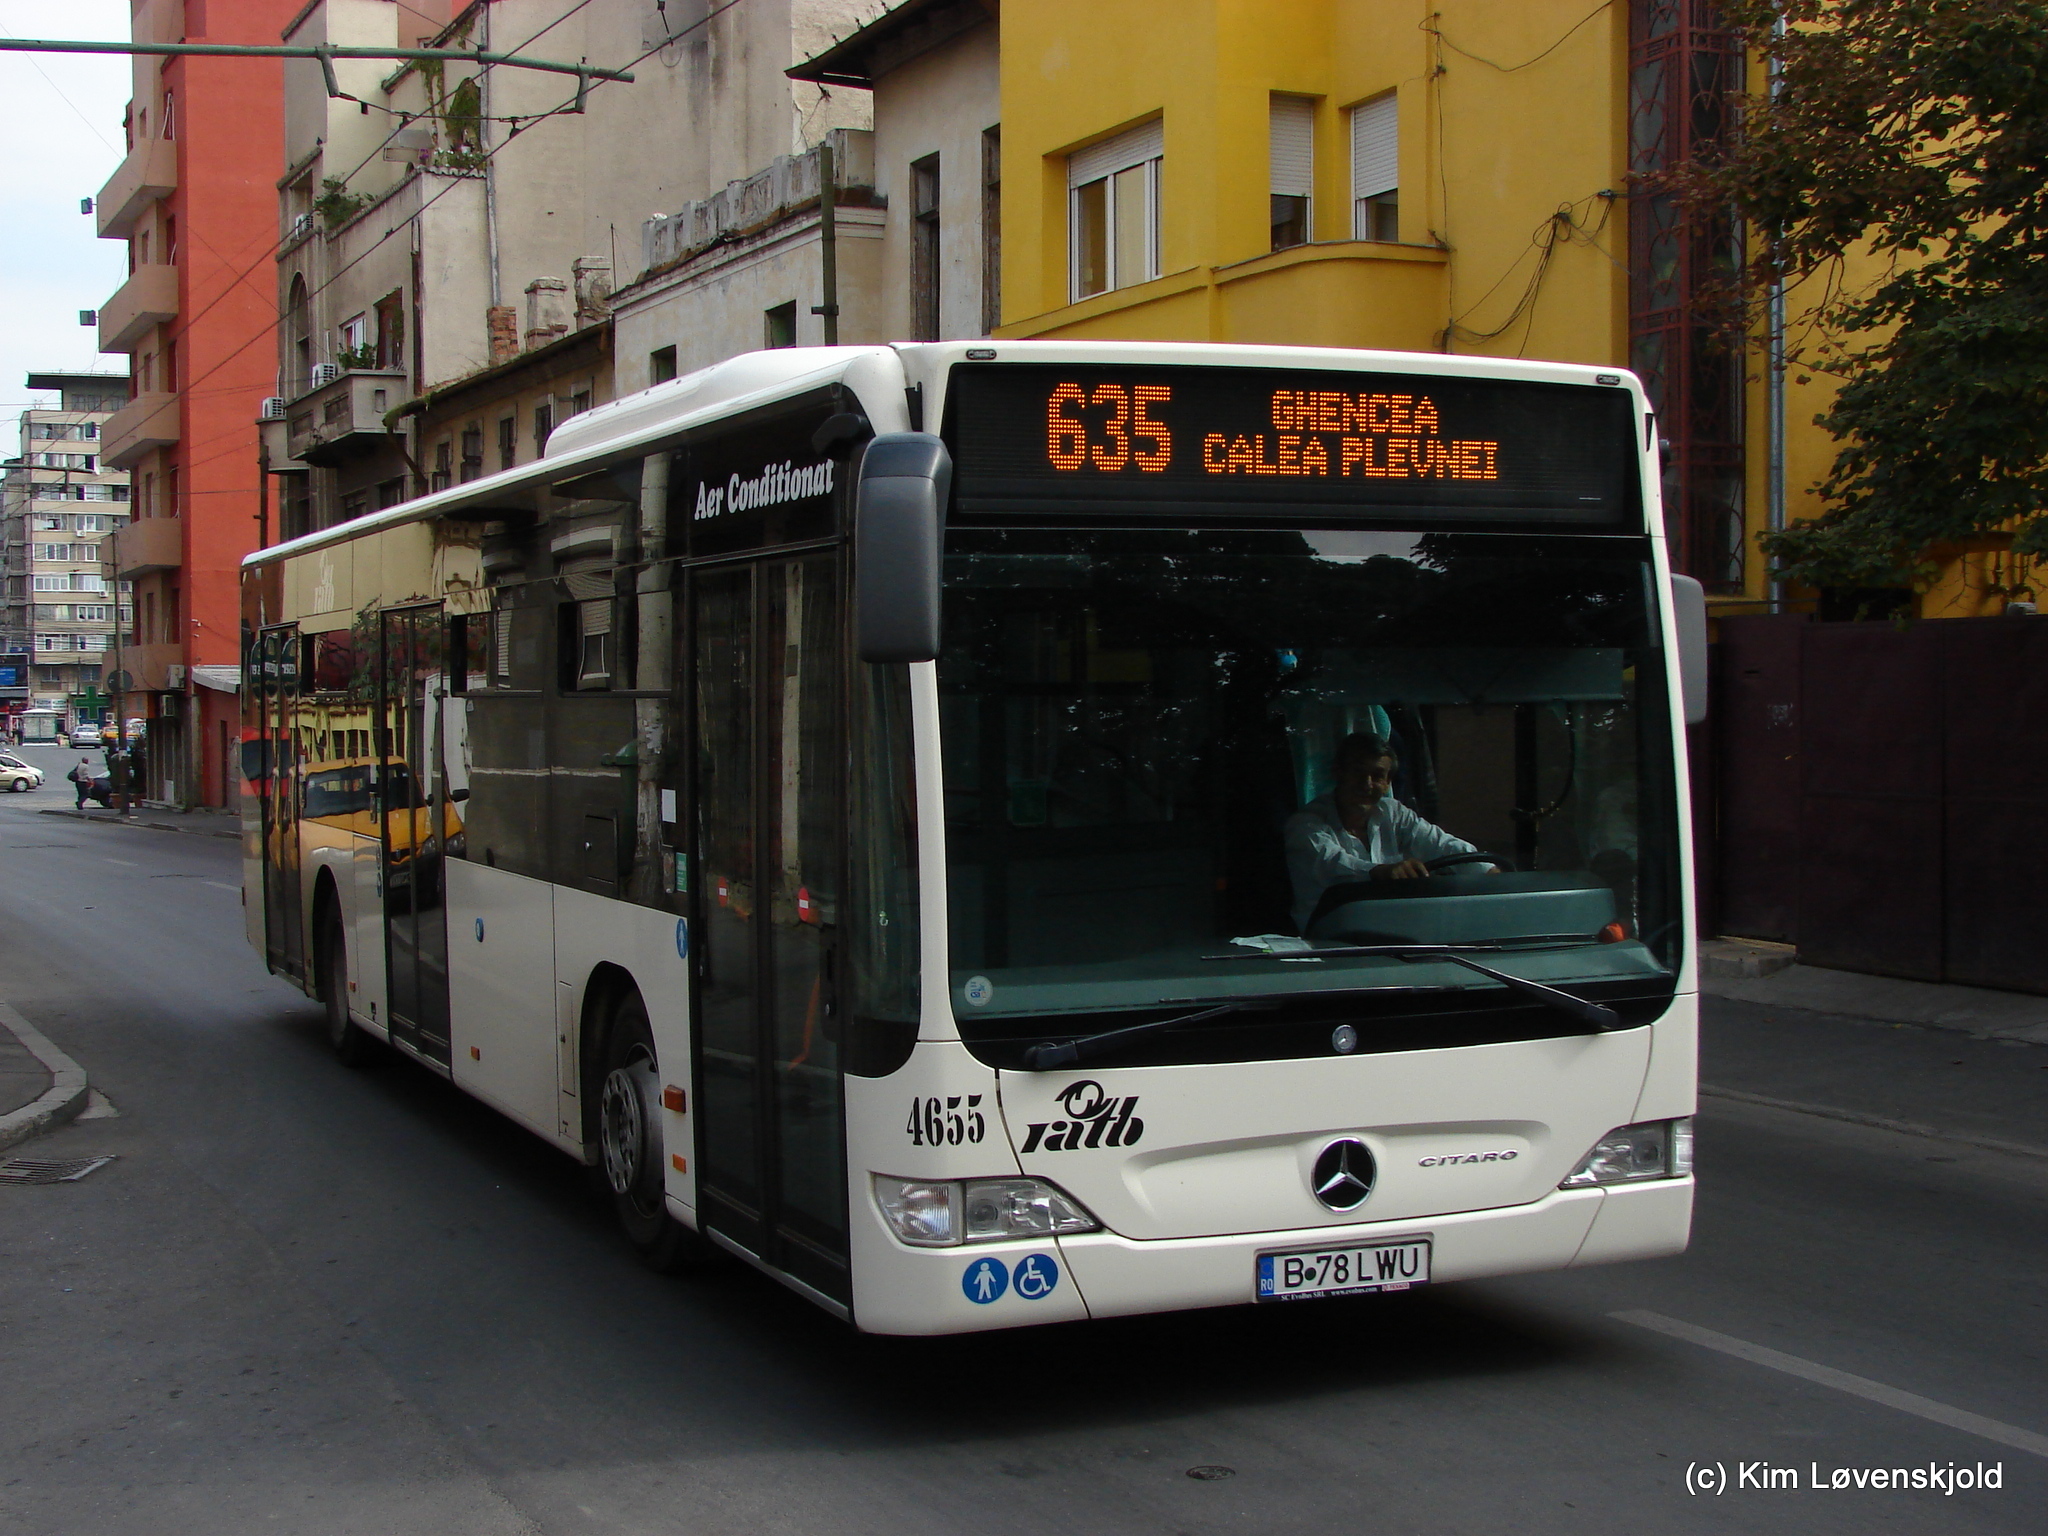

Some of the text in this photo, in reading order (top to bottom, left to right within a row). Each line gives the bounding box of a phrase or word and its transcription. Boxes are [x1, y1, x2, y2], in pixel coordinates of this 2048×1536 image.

[1047, 382, 1171, 471] 635
[1272, 390, 1438, 435] GHENCEA
[1203, 433, 1498, 480] CALEA PLEVNEI
[694, 458, 835, 521] Aer Conditionat
[906, 1094, 985, 1147] 4655
[1417, 1148, 1518, 1168] CITARO
[1260, 1278, 1274, 1291] RO
[1357, 1247, 1418, 1282] LWU
